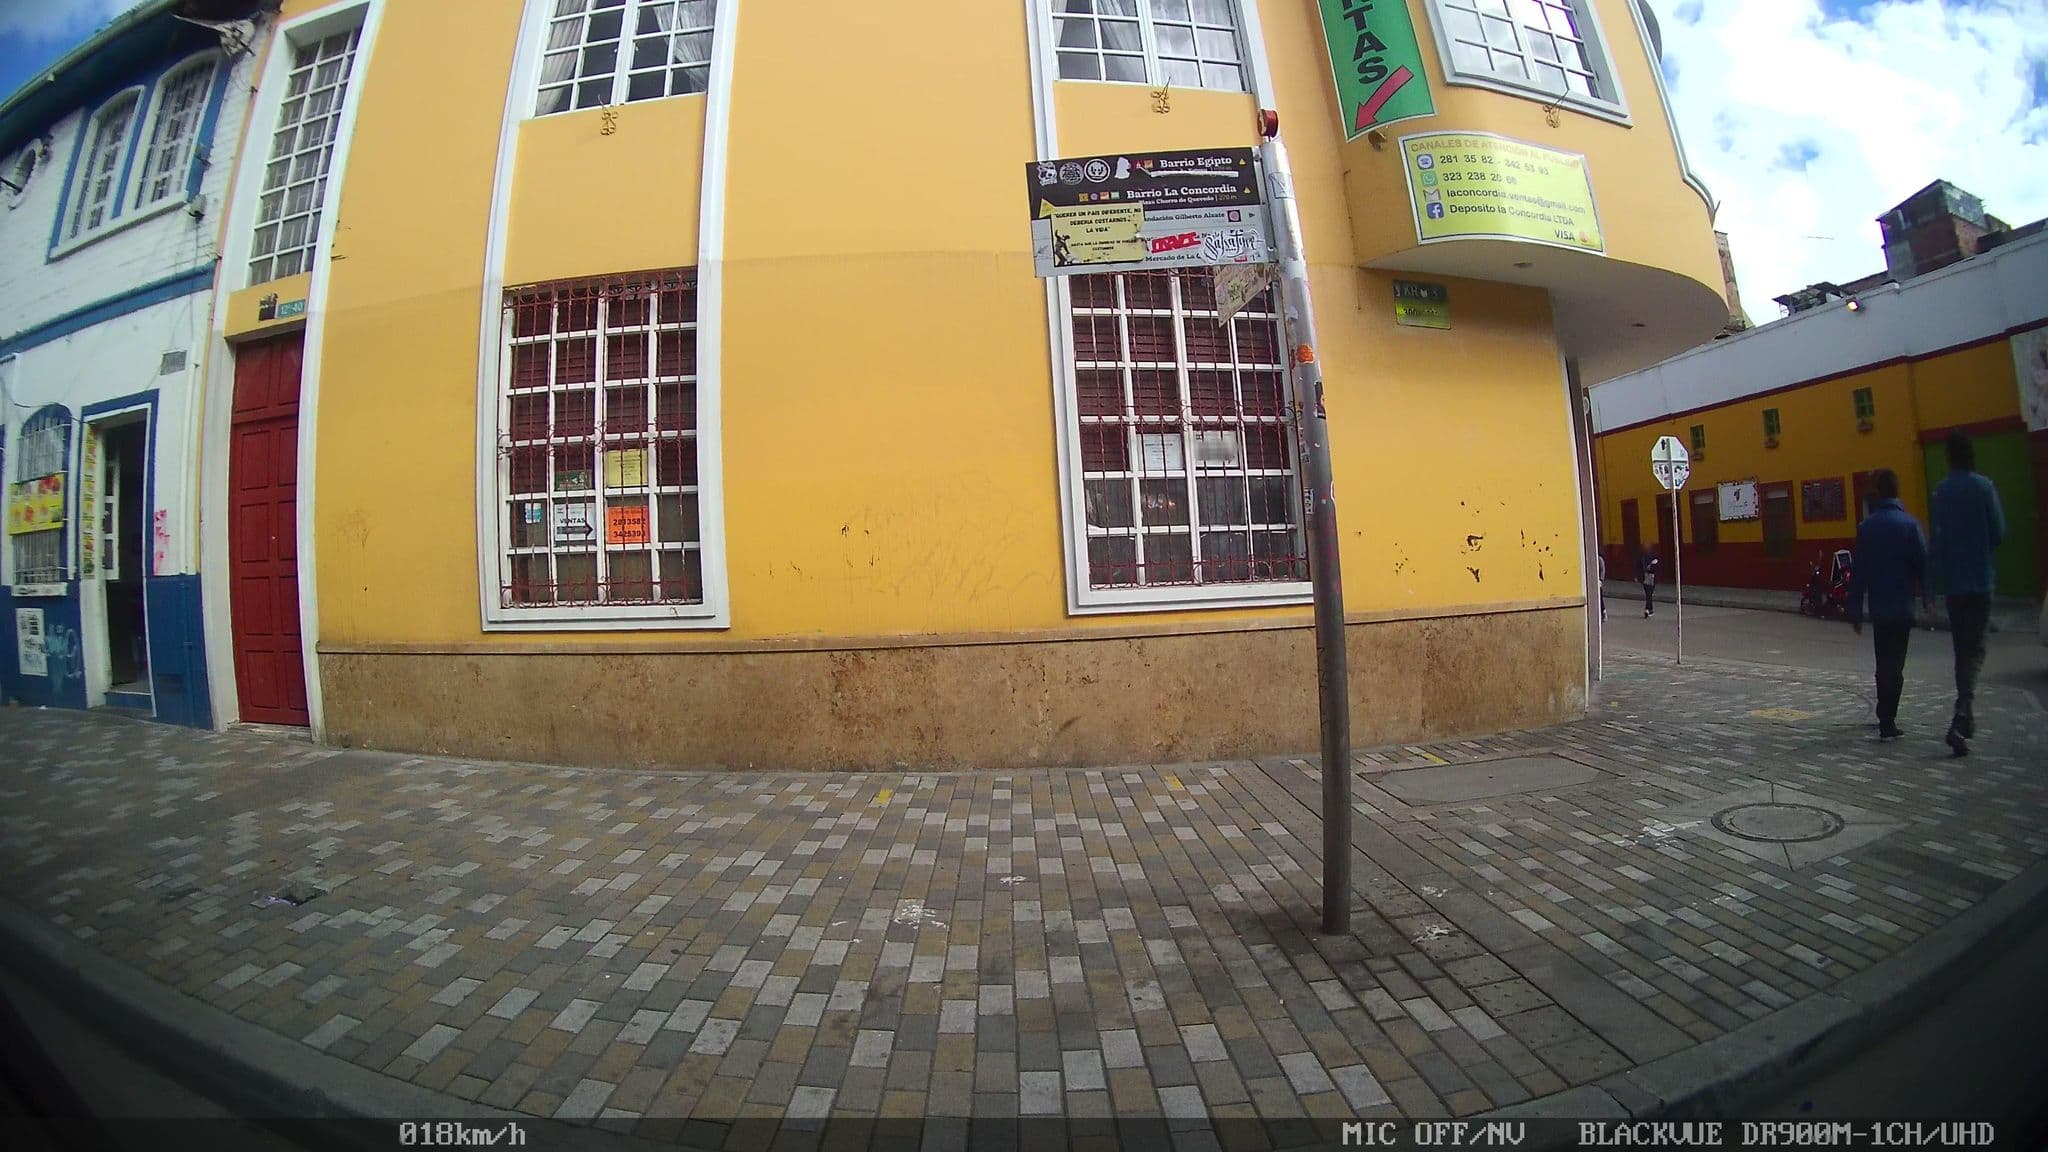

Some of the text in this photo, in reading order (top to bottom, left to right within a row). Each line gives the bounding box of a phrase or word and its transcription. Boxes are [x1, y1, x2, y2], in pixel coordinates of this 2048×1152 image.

[1342, 0, 1388, 84] TAS
[1411, 140, 1462, 152] CANALES
[1465, 140, 1480, 148] DE
[1160, 156, 1232, 168] Barrio Egipto
[1440, 155, 1458, 164] 281
[1464, 154, 1477, 163] 35
[1481, 155, 1494, 164] 82
[1443, 172, 1462, 182] 323
[1467, 171, 1486, 181] 238
[1126, 184, 1237, 199] Barrio La Concordia
[1450, 204, 1574, 226] Deposito la Concordia LTDA
[1554, 229, 1575, 241] VISA
